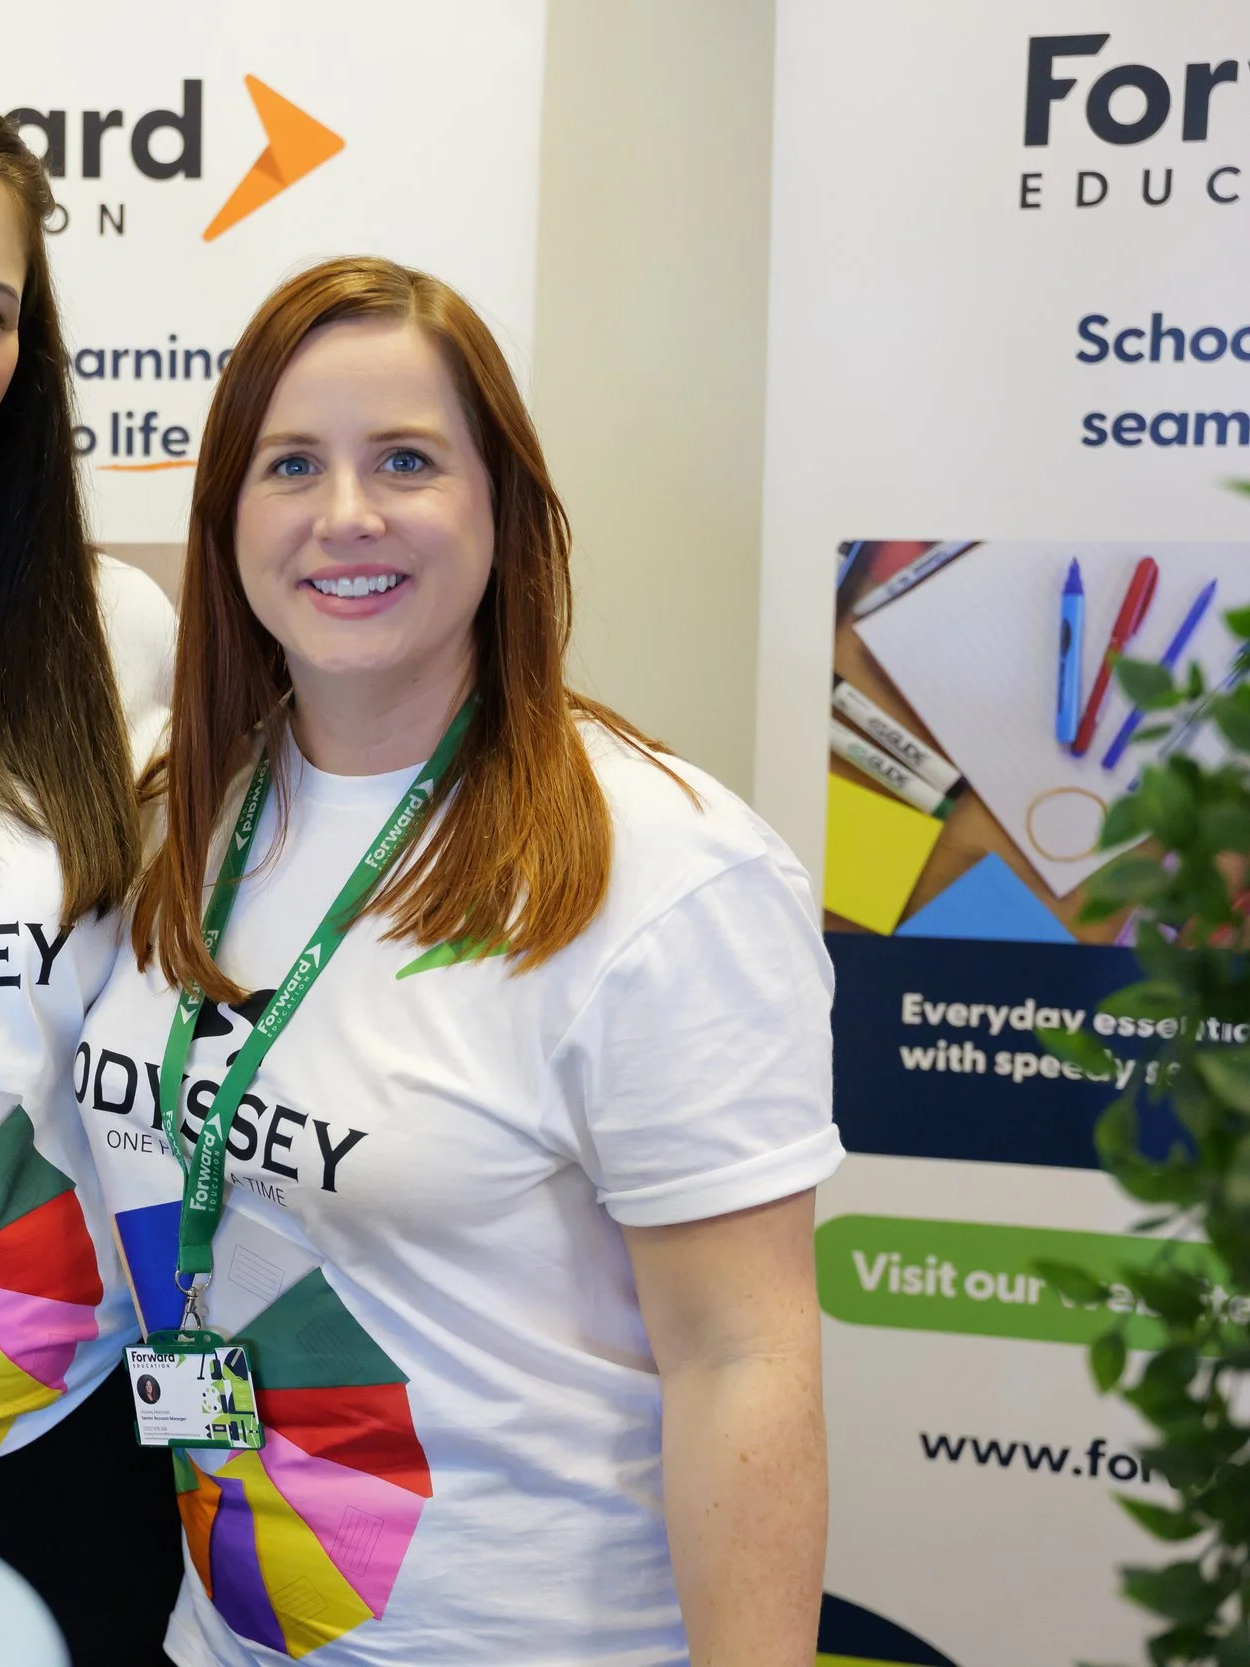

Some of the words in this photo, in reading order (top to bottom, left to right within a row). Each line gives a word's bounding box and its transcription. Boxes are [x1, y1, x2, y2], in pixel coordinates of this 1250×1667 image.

[1024, 33, 1250, 147] For
[1020, 166, 1240, 209] EDUC
[111, 411, 190, 457] life
[365, 794, 424, 868] Forward
[257, 959, 311, 1034] Forward
[267, 976, 310, 1038] EDUCATION
[902, 993, 1086, 1036] Everyday
[900, 1040, 987, 1074] with
[107, 1129, 152, 1153] ONE
[190, 1130, 216, 1210] Forward
[209, 1150, 220, 1212] EDUCATION
[230, 1172, 244, 1188] A
[243, 1176, 288, 1208] TIME
[852, 1250, 956, 1297] Visit
[964, 1270, 1046, 1304] our
[131, 1351, 176, 1363] Forward
